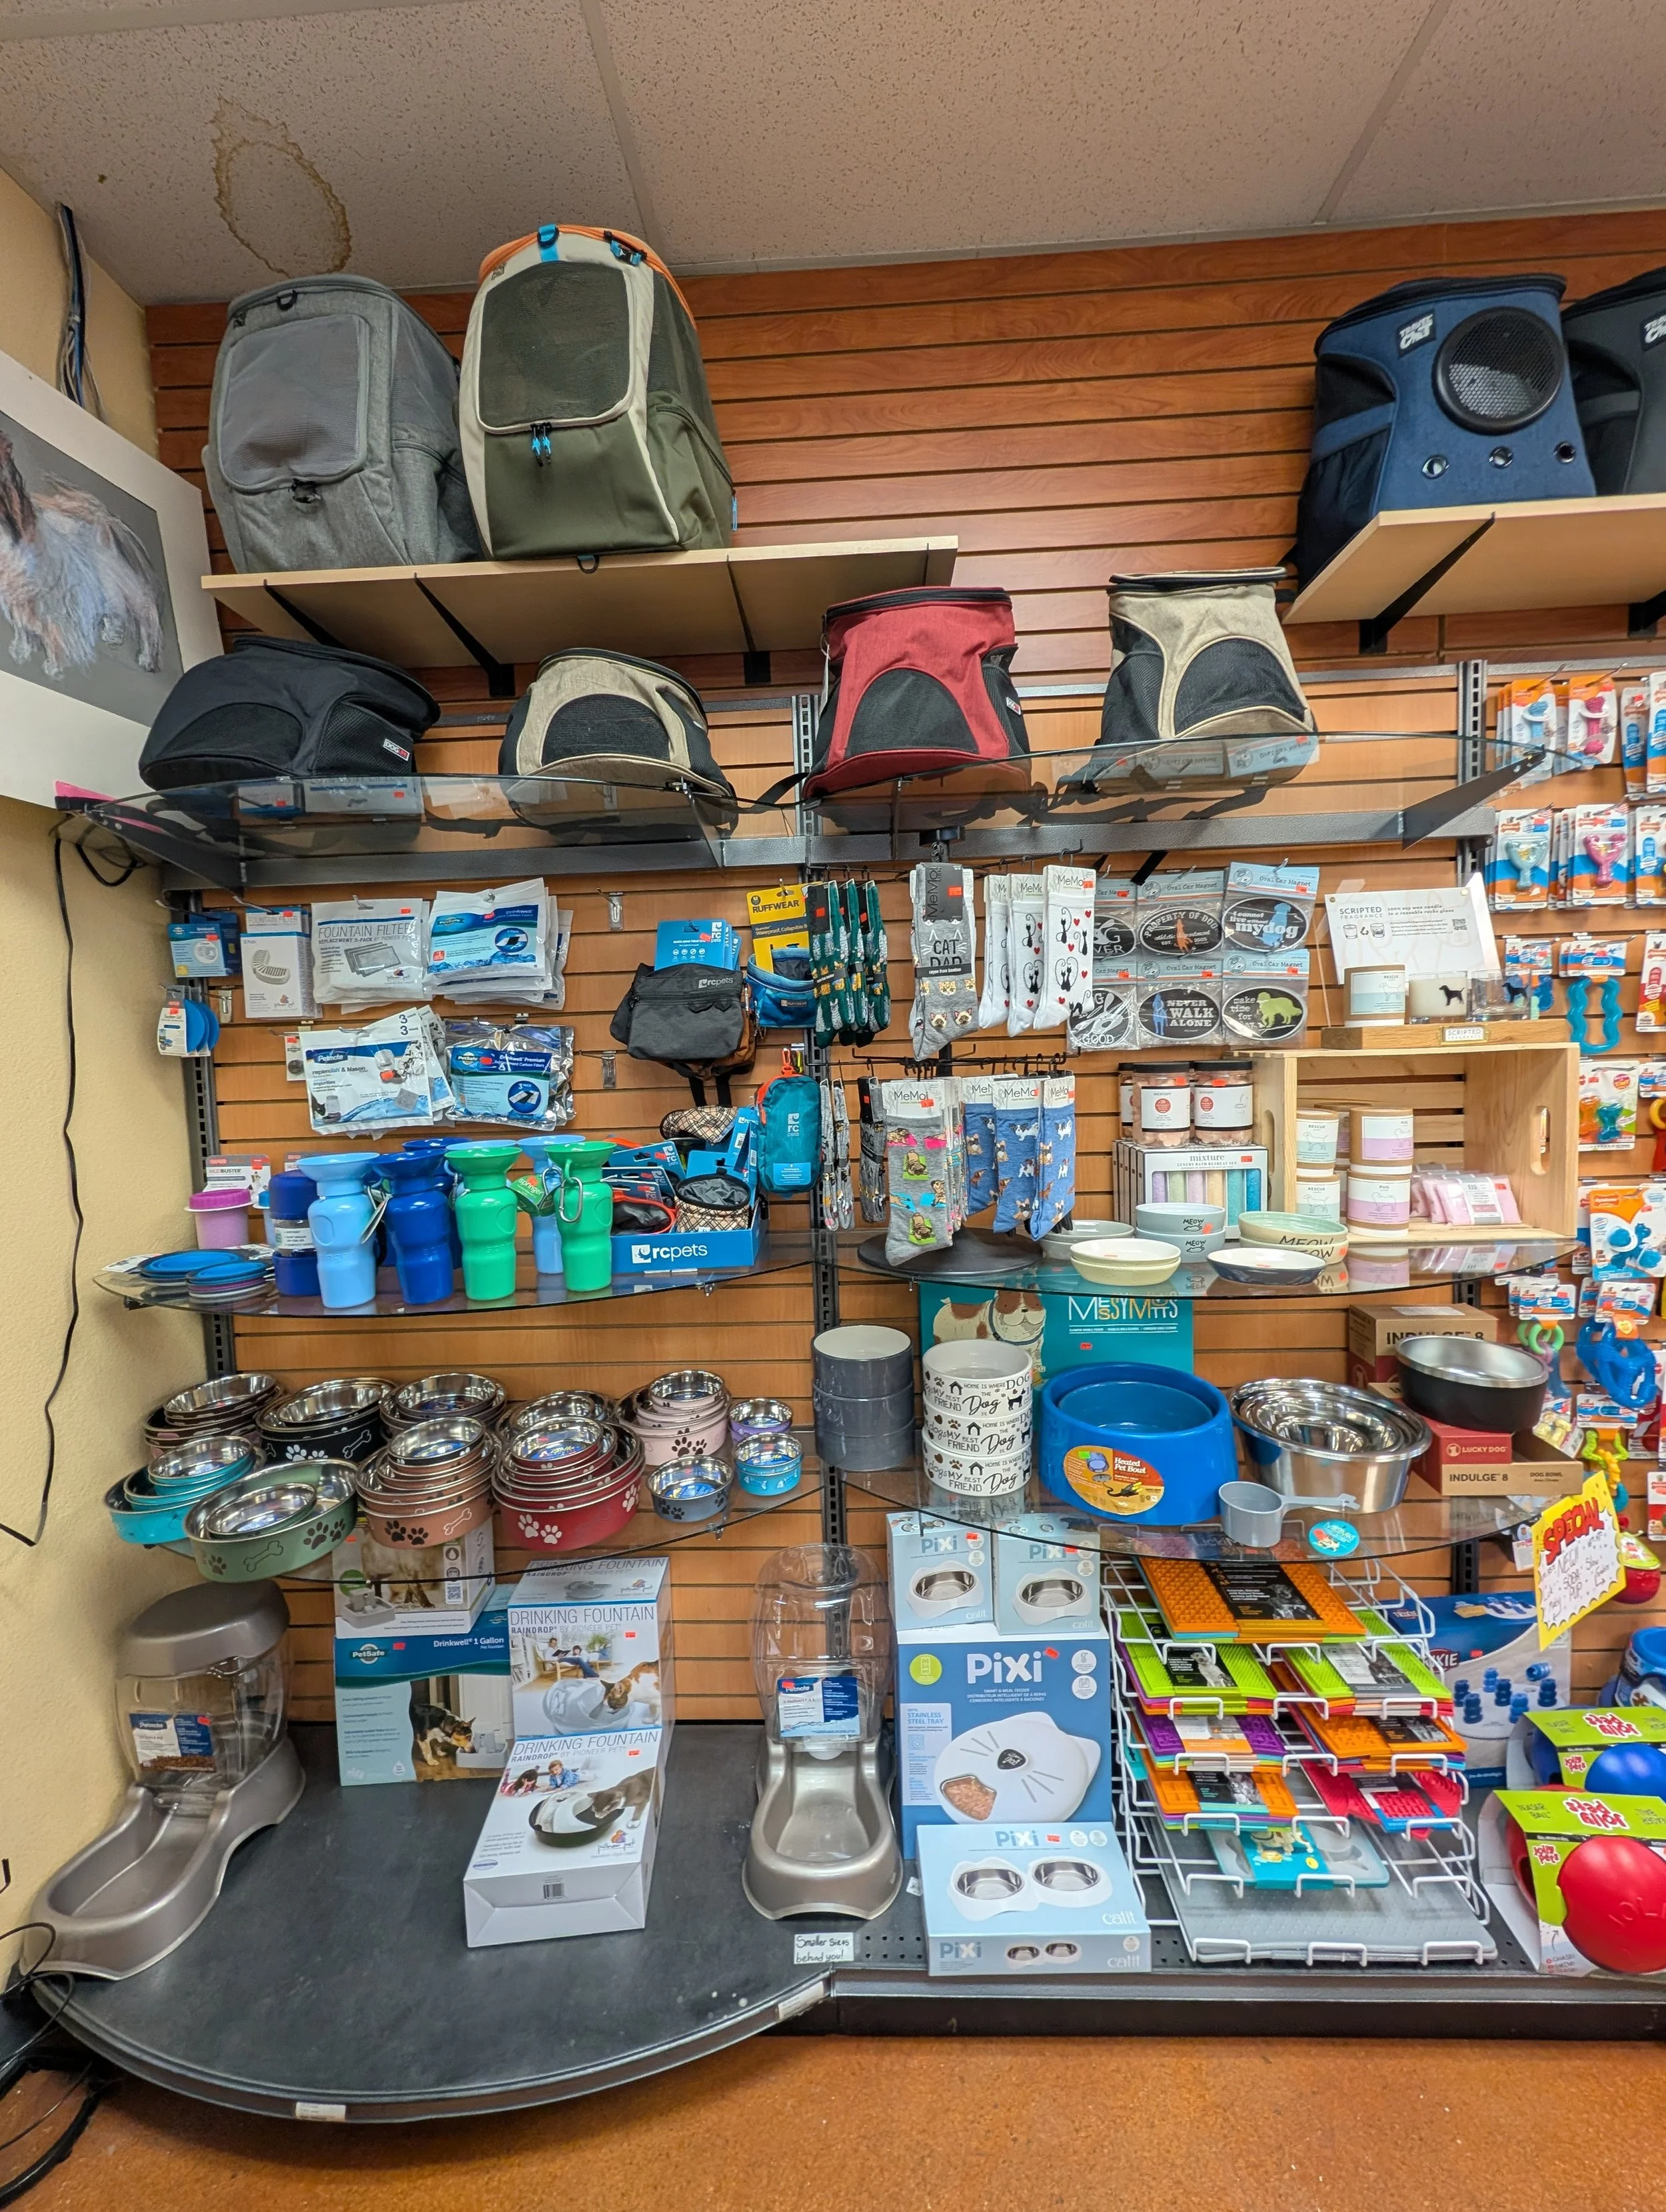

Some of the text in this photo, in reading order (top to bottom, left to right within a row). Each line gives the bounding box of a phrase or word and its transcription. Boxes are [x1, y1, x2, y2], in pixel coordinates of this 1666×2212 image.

[752, 900, 800, 913] RUFFWEAR
[319, 925, 373, 939] FOUNTAIN
[1145, 911, 1186, 938] PROPERTY
[1201, 915, 1218, 931] DOG
[933, 939, 958, 955] CAT
[399, 1014, 408, 1024] 3
[1170, 1007, 1214, 1018] WALK
[400, 1025, 409, 1035] 3
[1082, 1034, 1115, 1044] GOOD
[894, 1090, 928, 1101] MeMoi
[517, 1177, 544, 1196] springer
[652, 1243, 708, 1261] rcpets
[1006, 1372, 1030, 1390] DOG
[934, 1396, 962, 1411] FRIEND
[962, 1395, 1001, 1416] Dog
[947, 1430, 961, 1440] MY
[947, 1439, 980, 1452] FRIEND
[980, 1433, 1016, 1455] Dog
[1114, 1457, 1141, 1467] Heated
[1114, 1463, 1146, 1474] Pet Bowl
[948, 1471, 962, 1480] MY
[983, 1472, 1018, 1494] Dog
[949, 1479, 982, 1492] FRIEND
[922, 1535, 958, 1554] Pixi
[598, 1558, 665, 1570] FOUNTAIN
[510, 1606, 654, 1626] DRINKING FOUNTAIN
[479, 1636, 504, 1645] Gallon
[352, 1650, 385, 1658] PetSafe
[967, 1651, 1042, 1684] Pixi
[514, 1731, 658, 1756] DRINKING FOUNTAIN
[511, 1753, 554, 1763] RAINDROP
[572, 1748, 605, 1758] PIONEER
[996, 1830, 1039, 1847] Pixi
[1102, 1910, 1136, 1926] catit
[796, 1935, 827, 1948] Smaller
[940, 1941, 982, 1959] Pixi
[1108, 1953, 1140, 1968] catit
